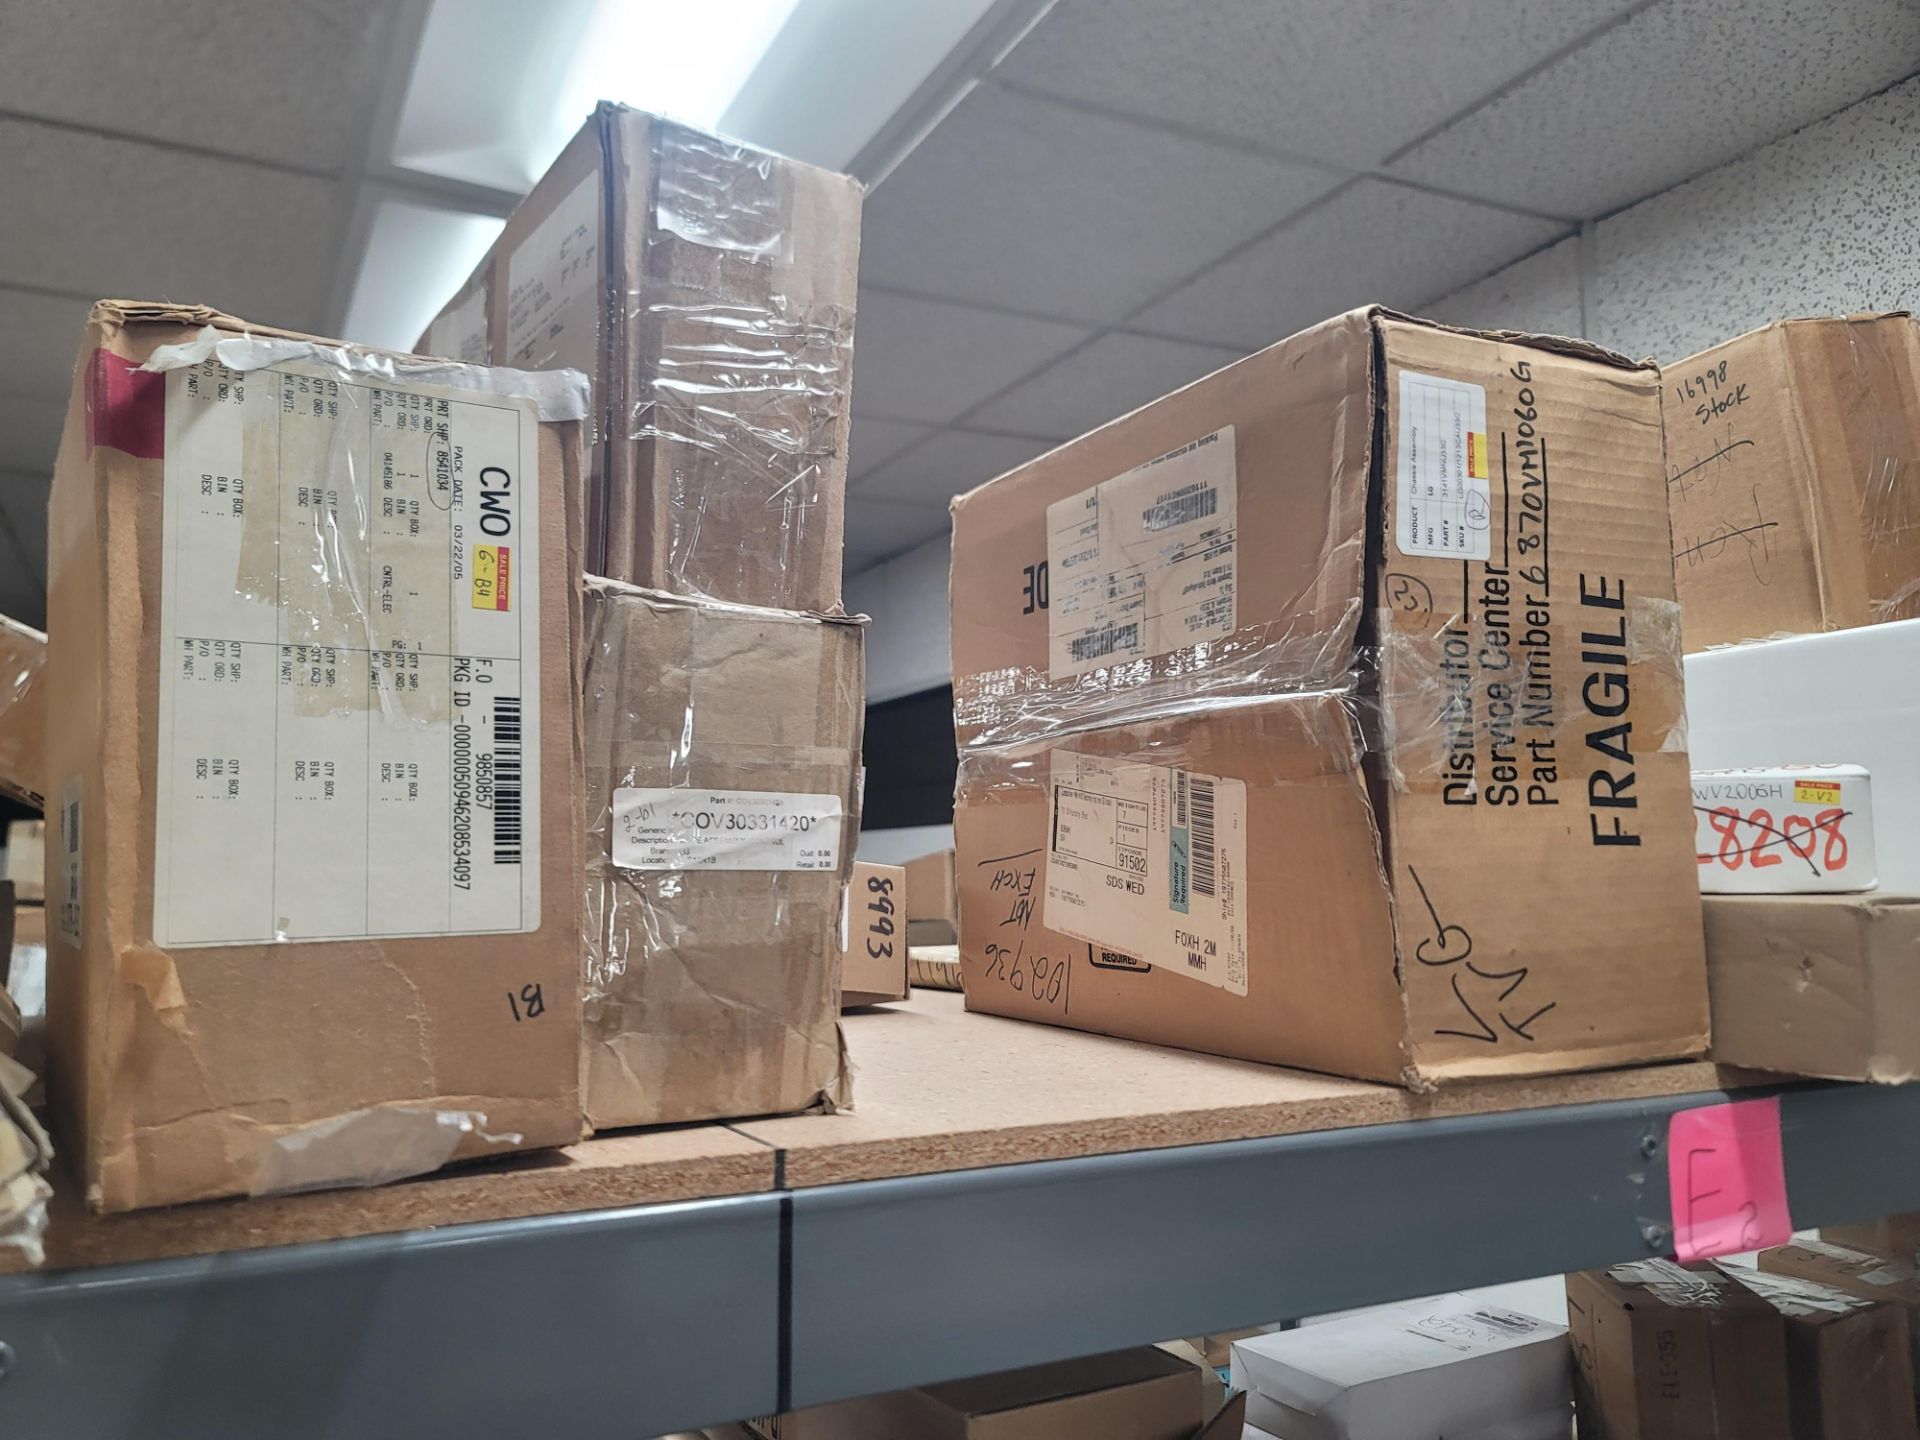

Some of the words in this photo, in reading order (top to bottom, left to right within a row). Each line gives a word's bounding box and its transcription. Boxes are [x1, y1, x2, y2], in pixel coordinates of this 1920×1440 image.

[234, 371, 245, 383] TY
[312, 378, 323, 395] QTY
[1676, 360, 1728, 403] 16998
[327, 381, 338, 397] QTY
[384, 391, 394, 407] P/O
[397, 393, 407, 409] QTY
[410, 394, 420, 411] QTY
[424, 398, 433, 413] PRT
[437, 400, 449, 418] PRT
[397, 411, 407, 430] ORD:
[410, 412, 420, 432] SHP:
[423, 415, 433, 434] ORD:
[437, 422, 449, 445] SHP:
[1410, 425, 1418, 463] Assembly
[454, 445, 463, 473] PACK
[436, 450, 449, 491] 8541034
[201, 474, 213, 496] DESC
[216, 476, 228, 493] BIN
[232, 478, 244, 495] QTY
[1427, 486, 1434, 496] LG
[298, 486, 309, 507] DESC
[312, 488, 323, 505] BIN
[327, 490, 338, 506] QTY
[454, 479, 463, 512] DATE:
[480, 466, 511, 537] CWO
[232, 498, 244, 518] BOX:
[383, 497, 392, 517] DESC
[396, 498, 406, 514] BIN
[409, 500, 420, 516] QTY
[409, 519, 420, 538] BOX:
[453, 524, 464, 580] 03/22/05
[499, 554, 507, 576] SALE
[382, 565, 393, 615] CNTRL-ELEC
[498, 576, 507, 601] PRICE
[1477, 561, 1511, 671] Center
[184, 639, 194, 651] WH
[199, 640, 210, 657] P/O
[214, 641, 225, 658] QTY
[230, 642, 241, 659] QTY
[281, 646, 292, 657] WH
[296, 647, 307, 663] P/O
[311, 646, 321, 664] QTY
[325, 648, 336, 665] QTY
[382, 652, 392, 668] P/O
[395, 653, 405, 669] QTY
[409, 654, 418, 669] QTY
[1518, 593, 1555, 727] Number
[183, 655, 194, 680] PART:
[214, 661, 225, 682] ORD:
[230, 662, 241, 683] SHP:
[281, 661, 292, 685] PART:
[454, 657, 471, 683] PKG
[325, 668, 336, 688] SHP:
[408, 673, 418, 692] SHP:
[454, 690, 471, 708] ID
[1440, 622, 1477, 805] Distributor
[1579, 573, 1641, 846] FRAGILE
[1483, 682, 1520, 807] Service
[196, 758, 207, 780] DESC
[212, 758, 223, 775] BIN
[228, 759, 239, 775] QTY
[295, 760, 306, 782] DESC
[309, 761, 320, 777] BIN
[324, 761, 335, 777] QTY
[381, 762, 391, 784] DESC
[395, 763, 405, 779] BIN
[408, 763, 418, 779] QTY
[1527, 739, 1560, 805] Part
[228, 779, 239, 799] BOX:
[324, 780, 335, 801] BOX:
[475, 753, 493, 810] 9850857
[408, 782, 418, 802] BOX:
[1118, 853, 1146, 874] 91502
[990, 867, 1037, 897] EXCH
[1106, 874, 1124, 890] SDS
[1125, 879, 1145, 895] WED
[1172, 861, 1180, 904] Signature
[1000, 897, 1037, 931] NOT
[1174, 929, 1200, 951] FOXH
[1204, 938, 1217, 957] 2M
[1187, 951, 1207, 971] MMH
[984, 940, 1072, 1015] 102936
